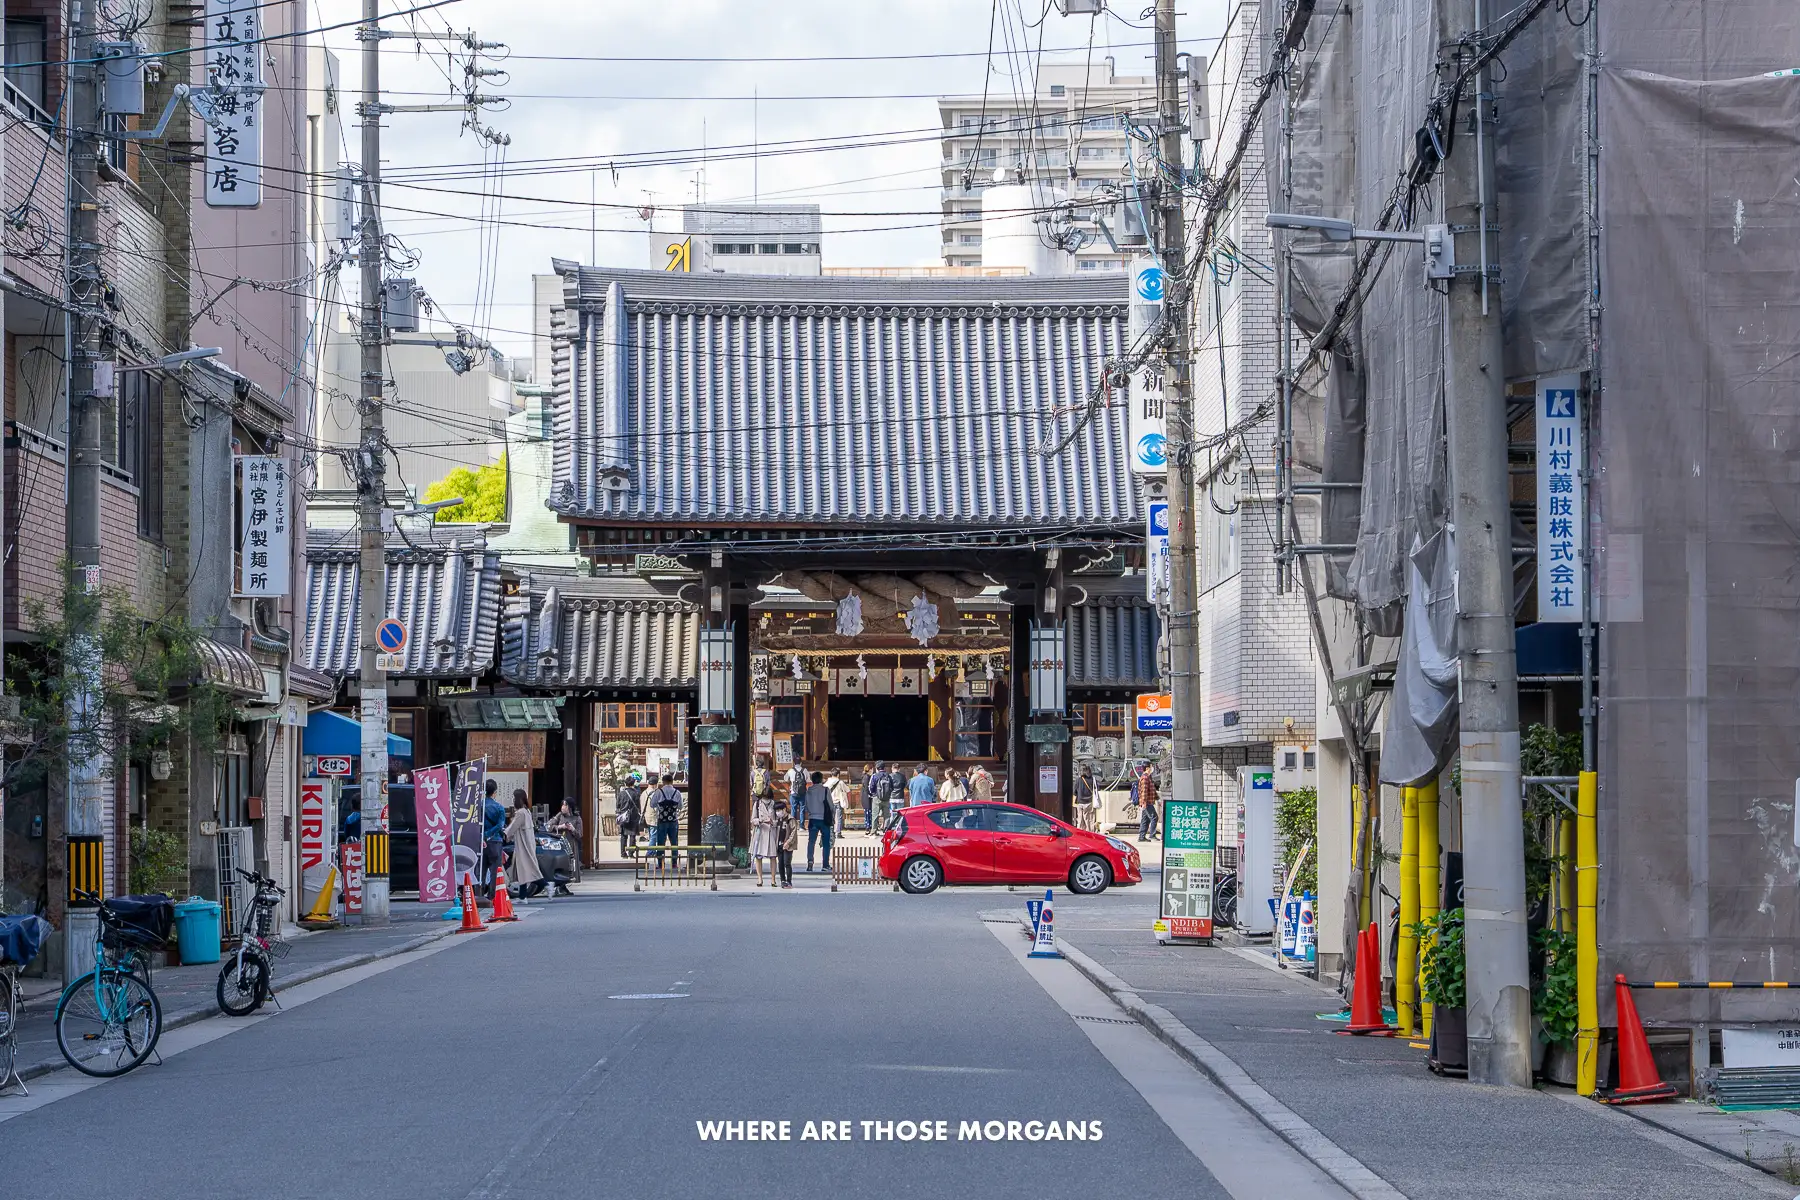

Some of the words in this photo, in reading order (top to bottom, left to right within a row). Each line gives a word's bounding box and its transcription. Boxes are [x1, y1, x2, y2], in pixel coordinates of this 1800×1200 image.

[665, 235, 692, 272] 21
[1549, 427, 1574, 608] 川村義肢株式会社
[250, 487, 268, 590] 宮伊製麺所
[322, 760, 346, 770] たばこ
[1171, 805, 1210, 817] おばら
[1171, 817, 1210, 829] 整体整骨
[302, 785, 322, 871] KIRIN
[1170, 829, 1210, 841] 鍼灸院
[465, 885, 473, 912] 駐車禁止
